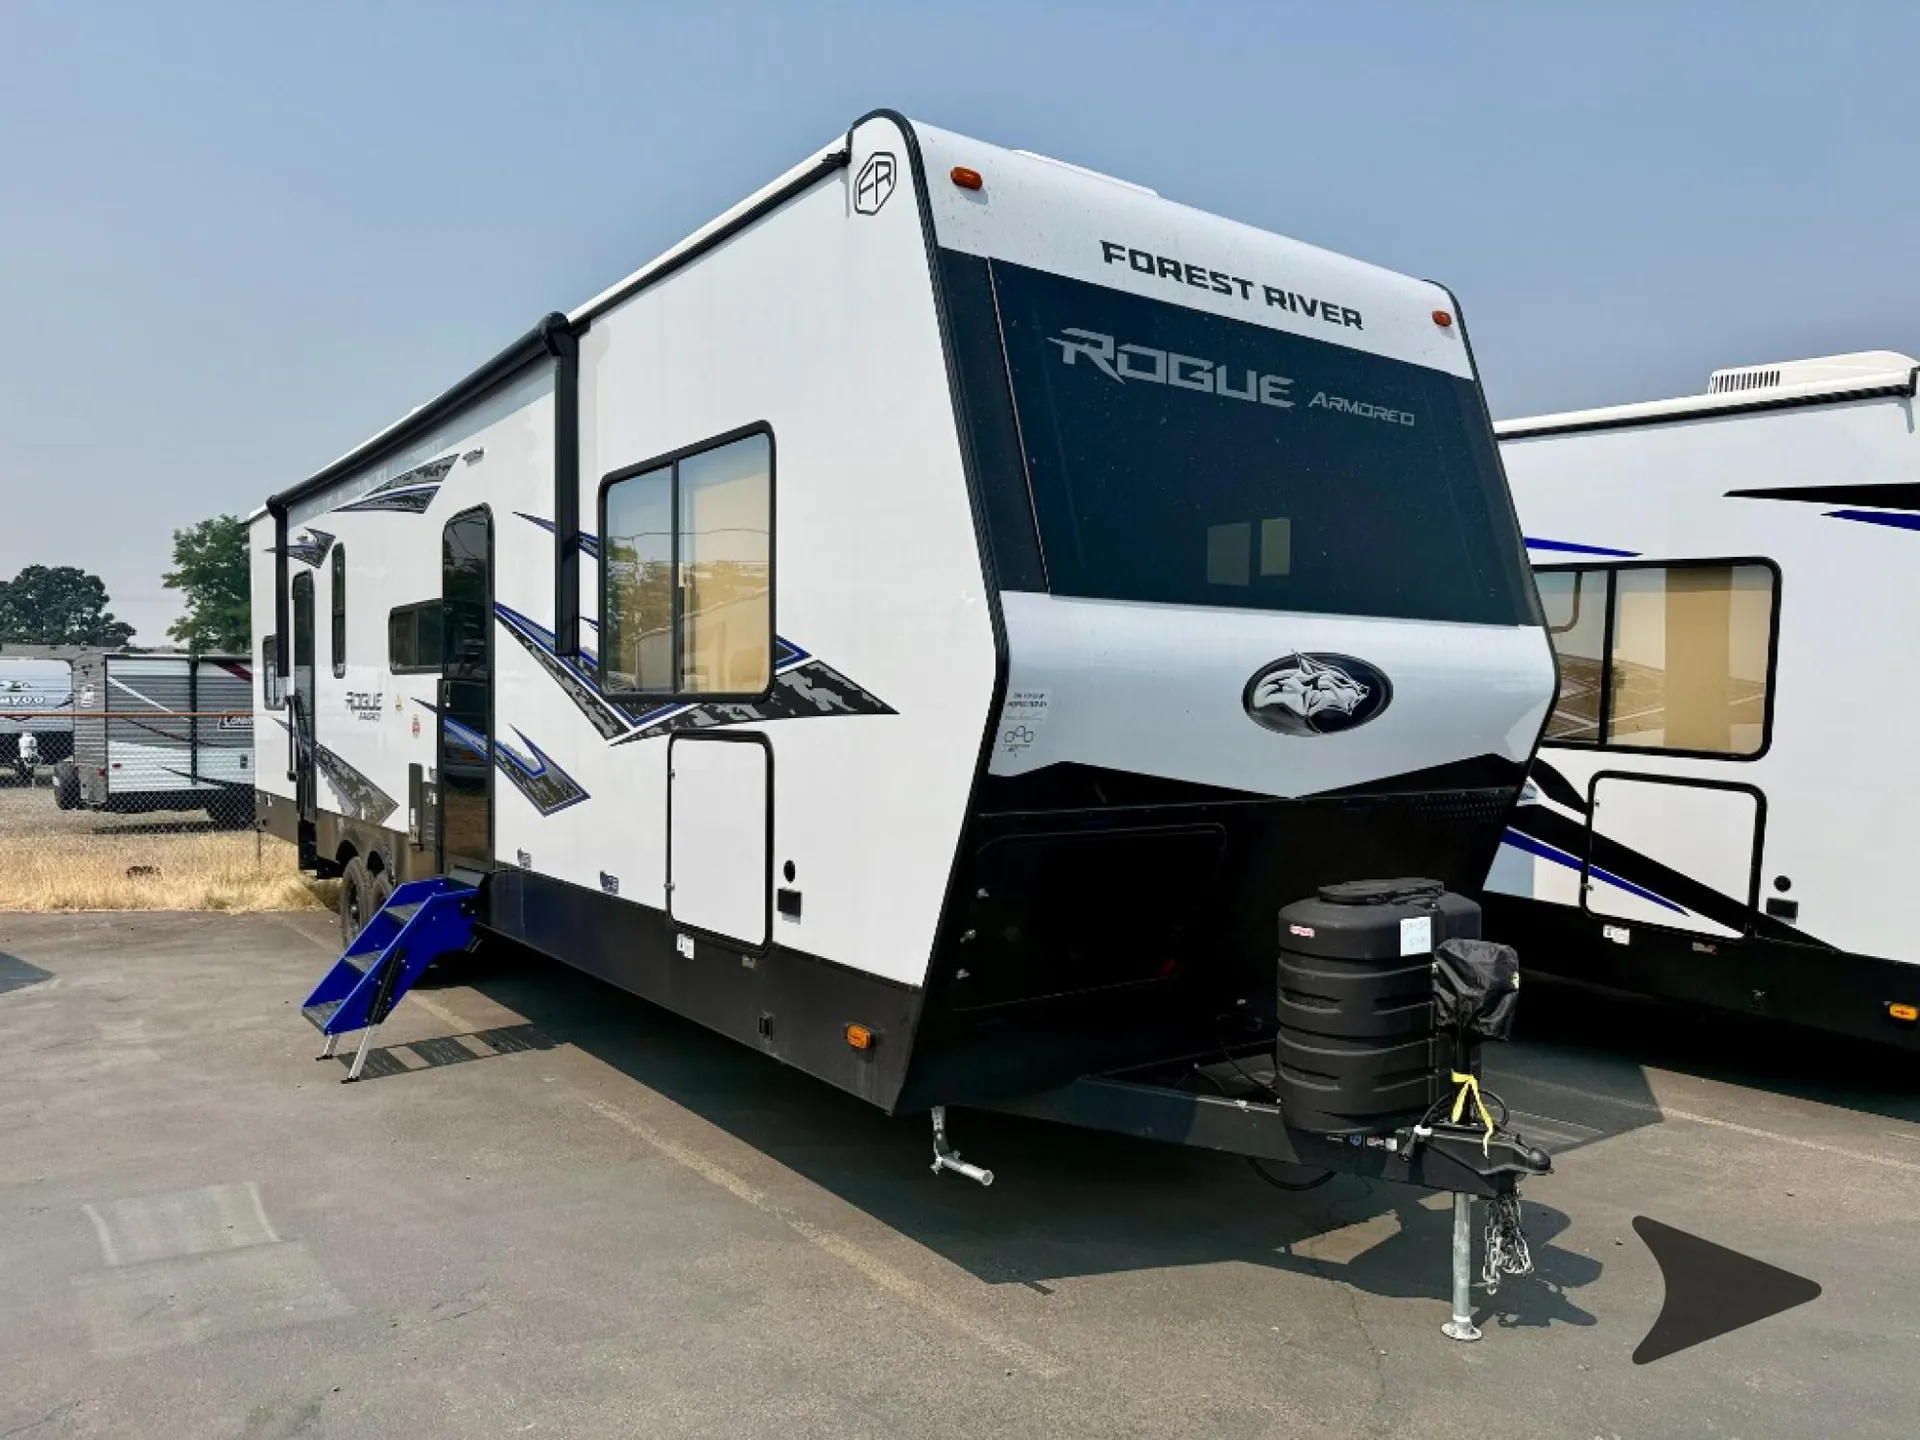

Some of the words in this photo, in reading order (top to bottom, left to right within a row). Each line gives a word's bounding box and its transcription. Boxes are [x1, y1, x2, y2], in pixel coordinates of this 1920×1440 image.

[1101, 240, 1254, 300] FOREST
[1261, 284, 1364, 331] RIVER
[1046, 327, 1296, 409] ROGUE
[1307, 391, 1415, 427] ARMORED
